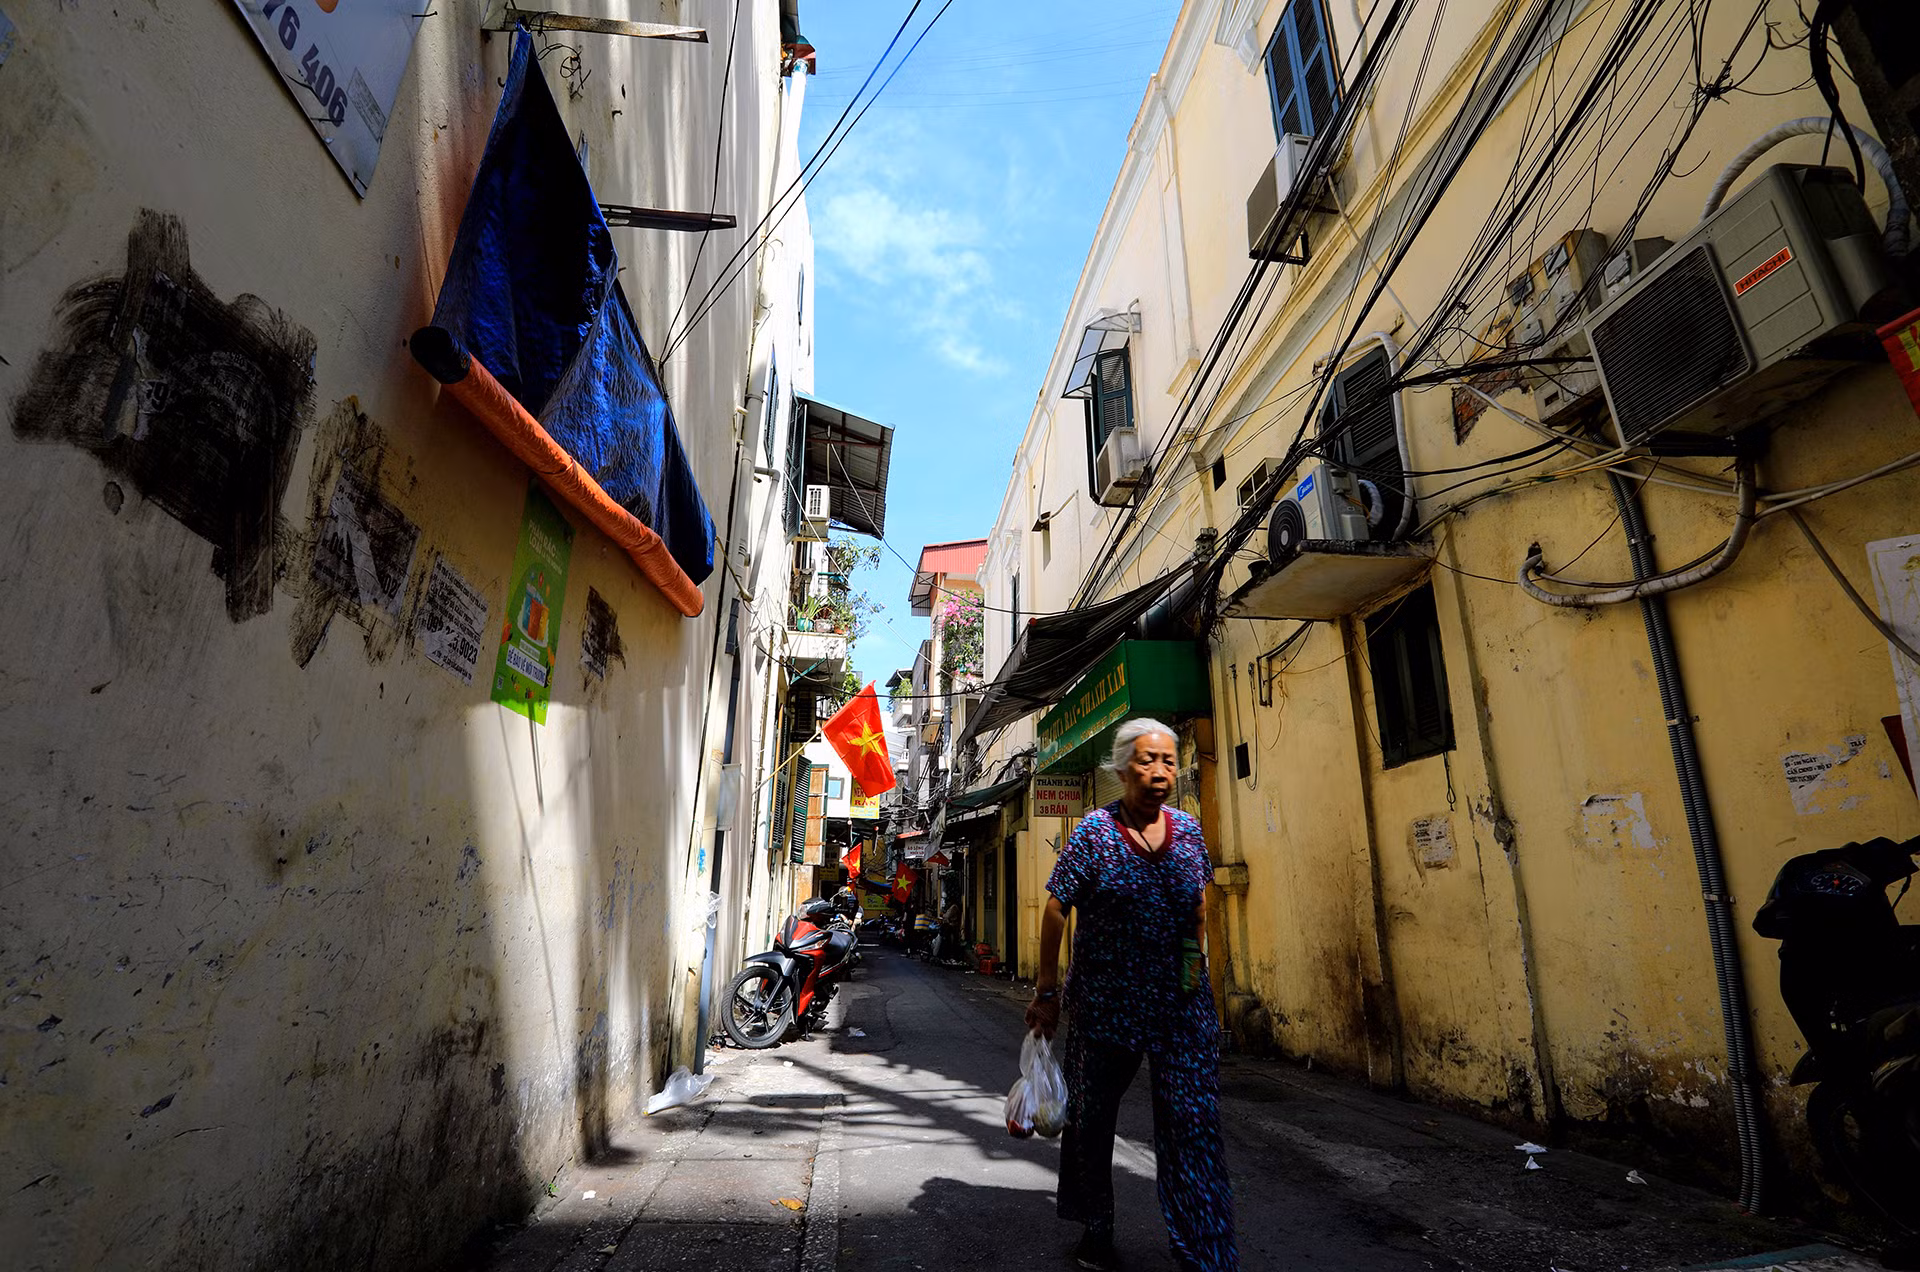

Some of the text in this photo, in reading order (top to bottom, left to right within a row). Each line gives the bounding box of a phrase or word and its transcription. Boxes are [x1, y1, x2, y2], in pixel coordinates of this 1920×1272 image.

[301, 43, 348, 128] 406
[1739, 253, 1786, 289] HITACHI
[1037, 791, 1081, 800] NEM CHUA
[1040, 802, 1068, 814] 38 RÁN
